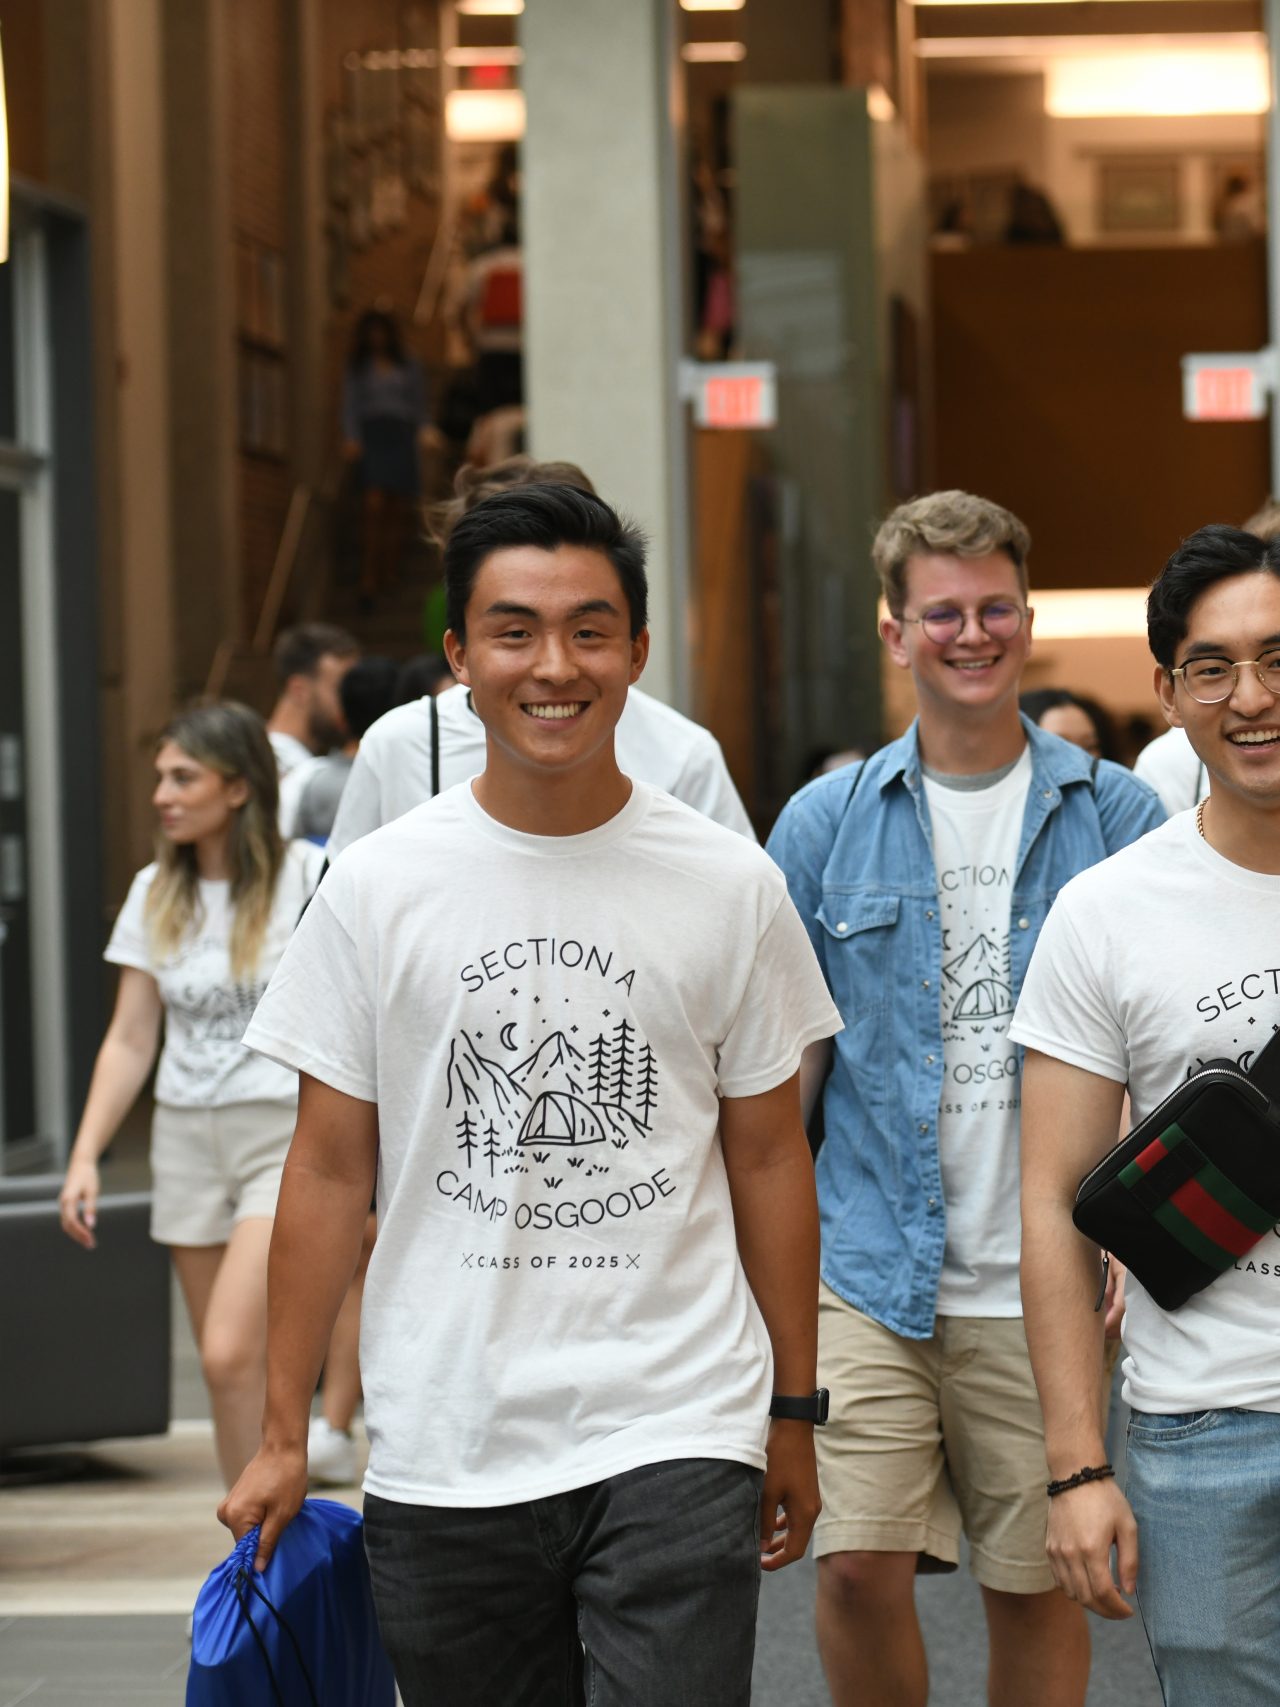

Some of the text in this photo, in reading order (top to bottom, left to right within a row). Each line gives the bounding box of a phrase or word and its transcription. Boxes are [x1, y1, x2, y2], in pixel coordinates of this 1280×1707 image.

[460, 938, 636, 997] SECTION A
[952, 1055, 1020, 1085] OSGO
[436, 1167, 677, 1230] CAMP OSGOODE
[530, 1256, 557, 1269] OF
[568, 1256, 619, 1269] 2025
